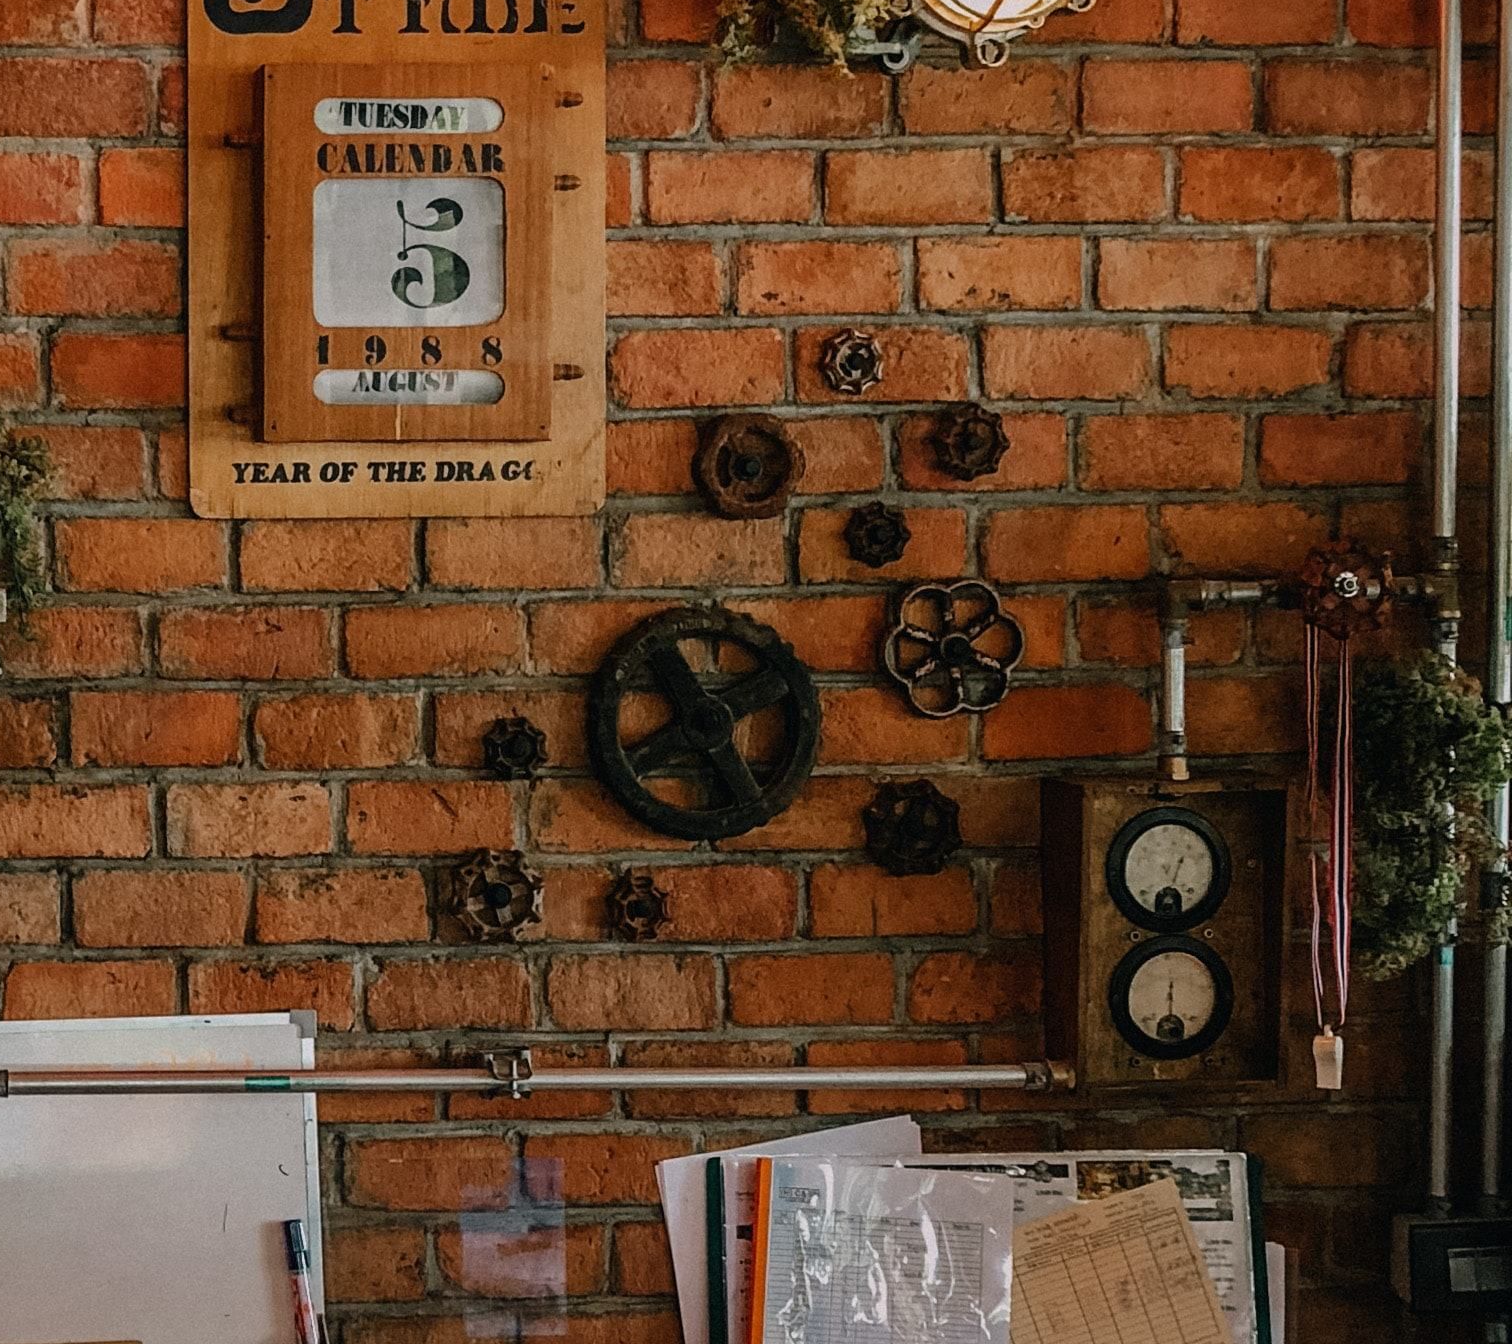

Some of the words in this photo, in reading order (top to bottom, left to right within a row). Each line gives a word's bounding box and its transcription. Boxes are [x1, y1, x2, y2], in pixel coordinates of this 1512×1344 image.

[339, 101, 466, 131] TUESDAY
[316, 143, 505, 173] CALENDAR
[391, 197, 471, 308] 5
[351, 370, 460, 393] AUGUST
[231, 462, 313, 484] YEAR
[318, 461, 358, 483] OF
[366, 462, 426, 483] THE
